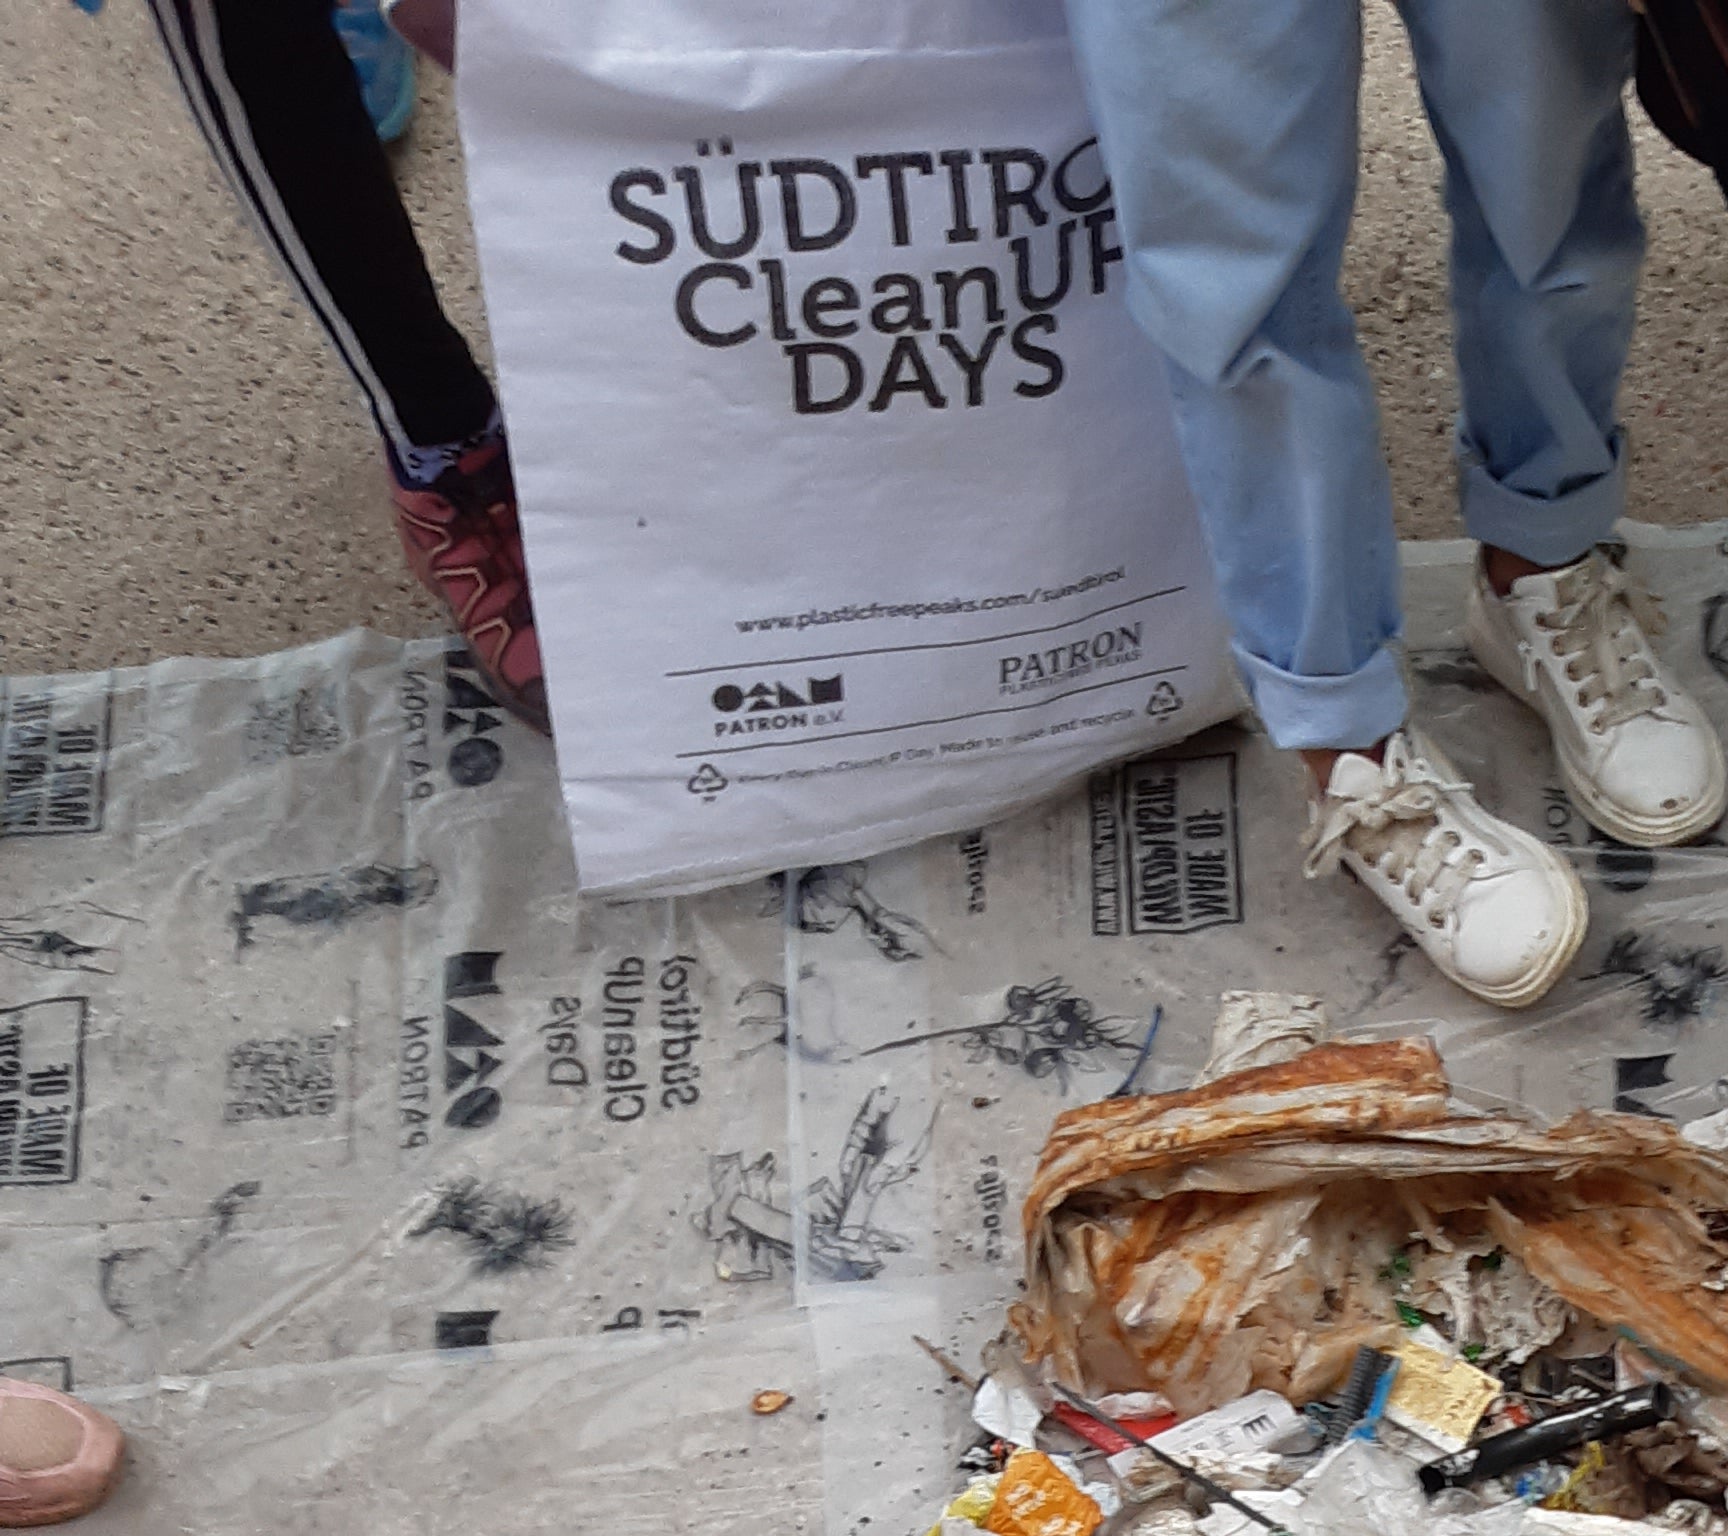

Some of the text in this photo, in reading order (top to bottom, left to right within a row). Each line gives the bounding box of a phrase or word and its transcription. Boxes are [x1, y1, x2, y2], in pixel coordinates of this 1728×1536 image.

[609, 136, 1113, 266] SÜDTIRO
[783, 314, 1065, 414] DAYS
[1000, 622, 1143, 684] PATRON
[714, 713, 808, 737] PATRON
